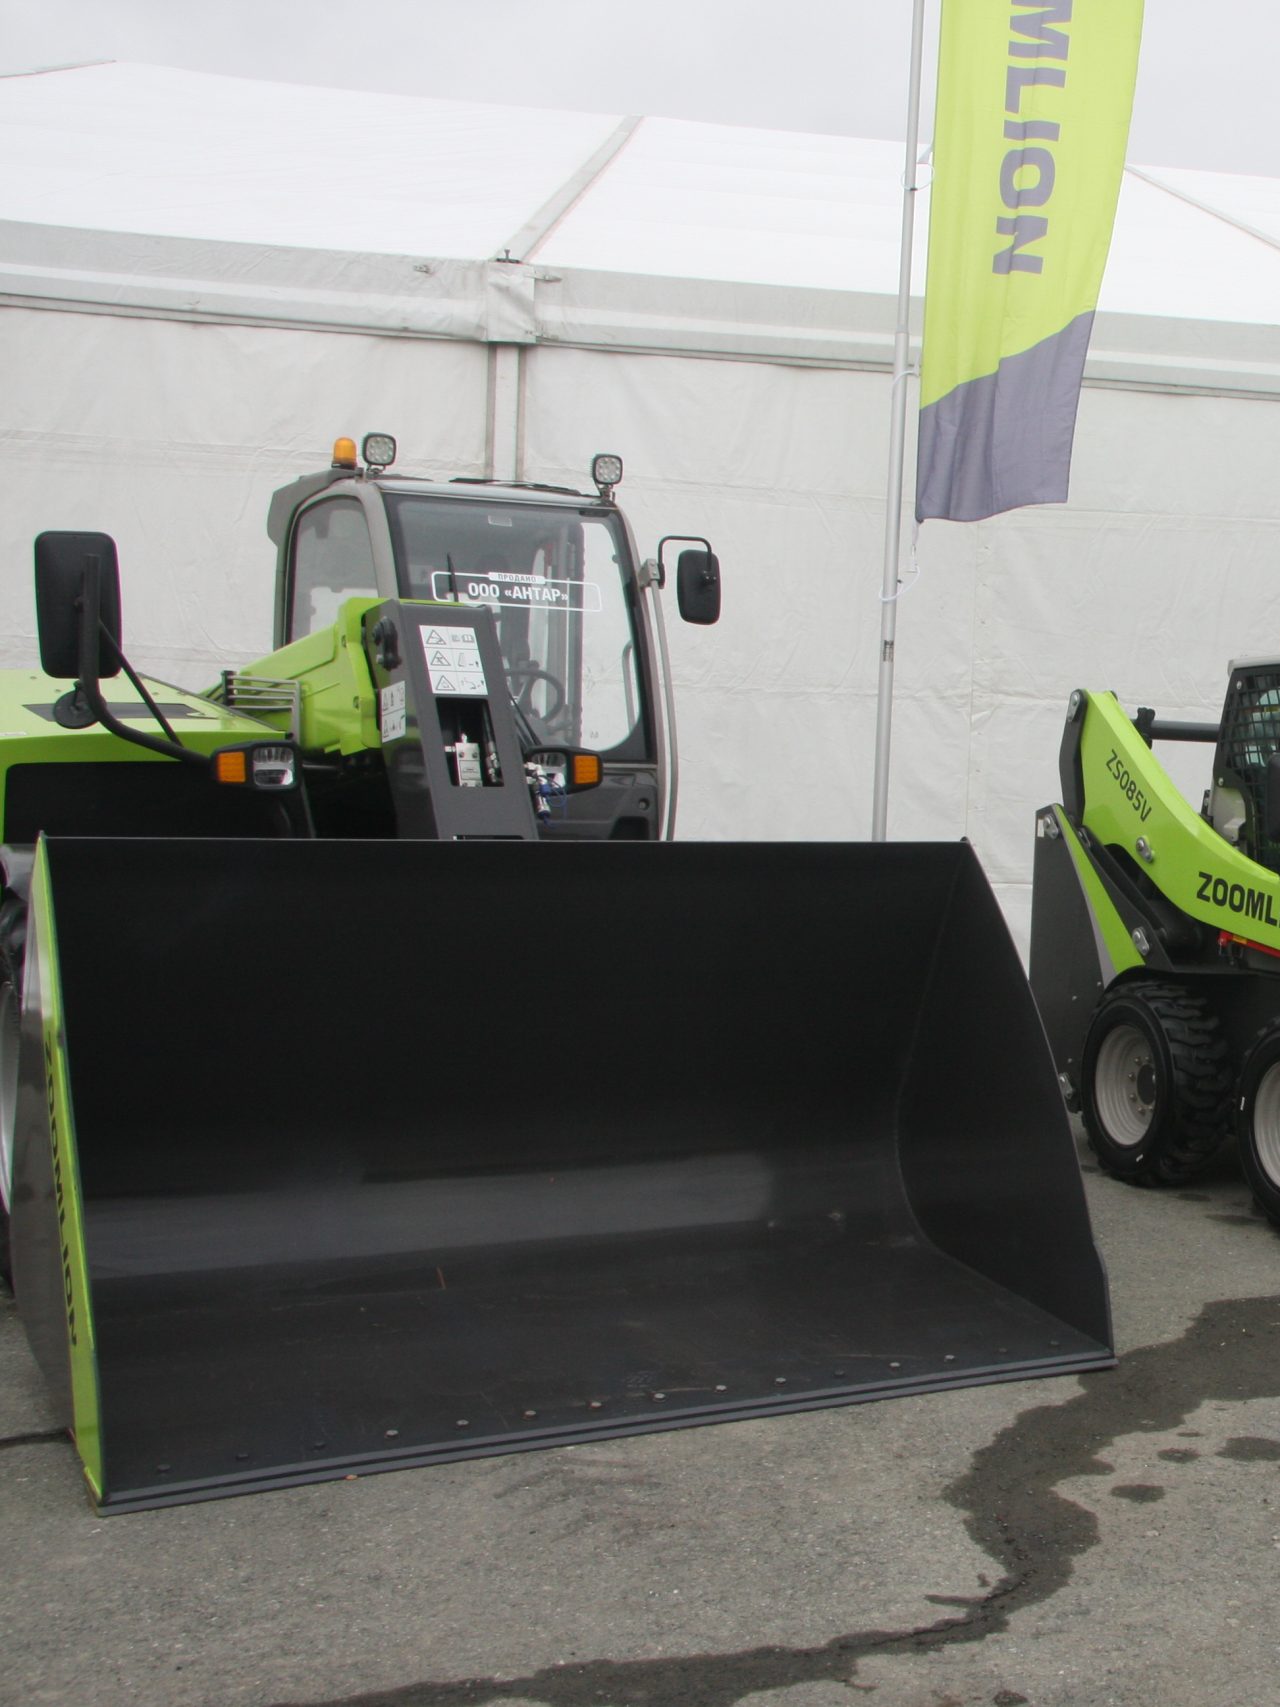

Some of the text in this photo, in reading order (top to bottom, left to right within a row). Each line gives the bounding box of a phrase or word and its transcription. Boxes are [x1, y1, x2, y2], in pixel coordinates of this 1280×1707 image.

[468, 582, 569, 602] ООО «АНТАР»
[497, 573, 537, 583] ПРОДАНО
[1105, 748, 1153, 823] ZS085V
[45, 1041, 77, 1347] ZOOMLION
